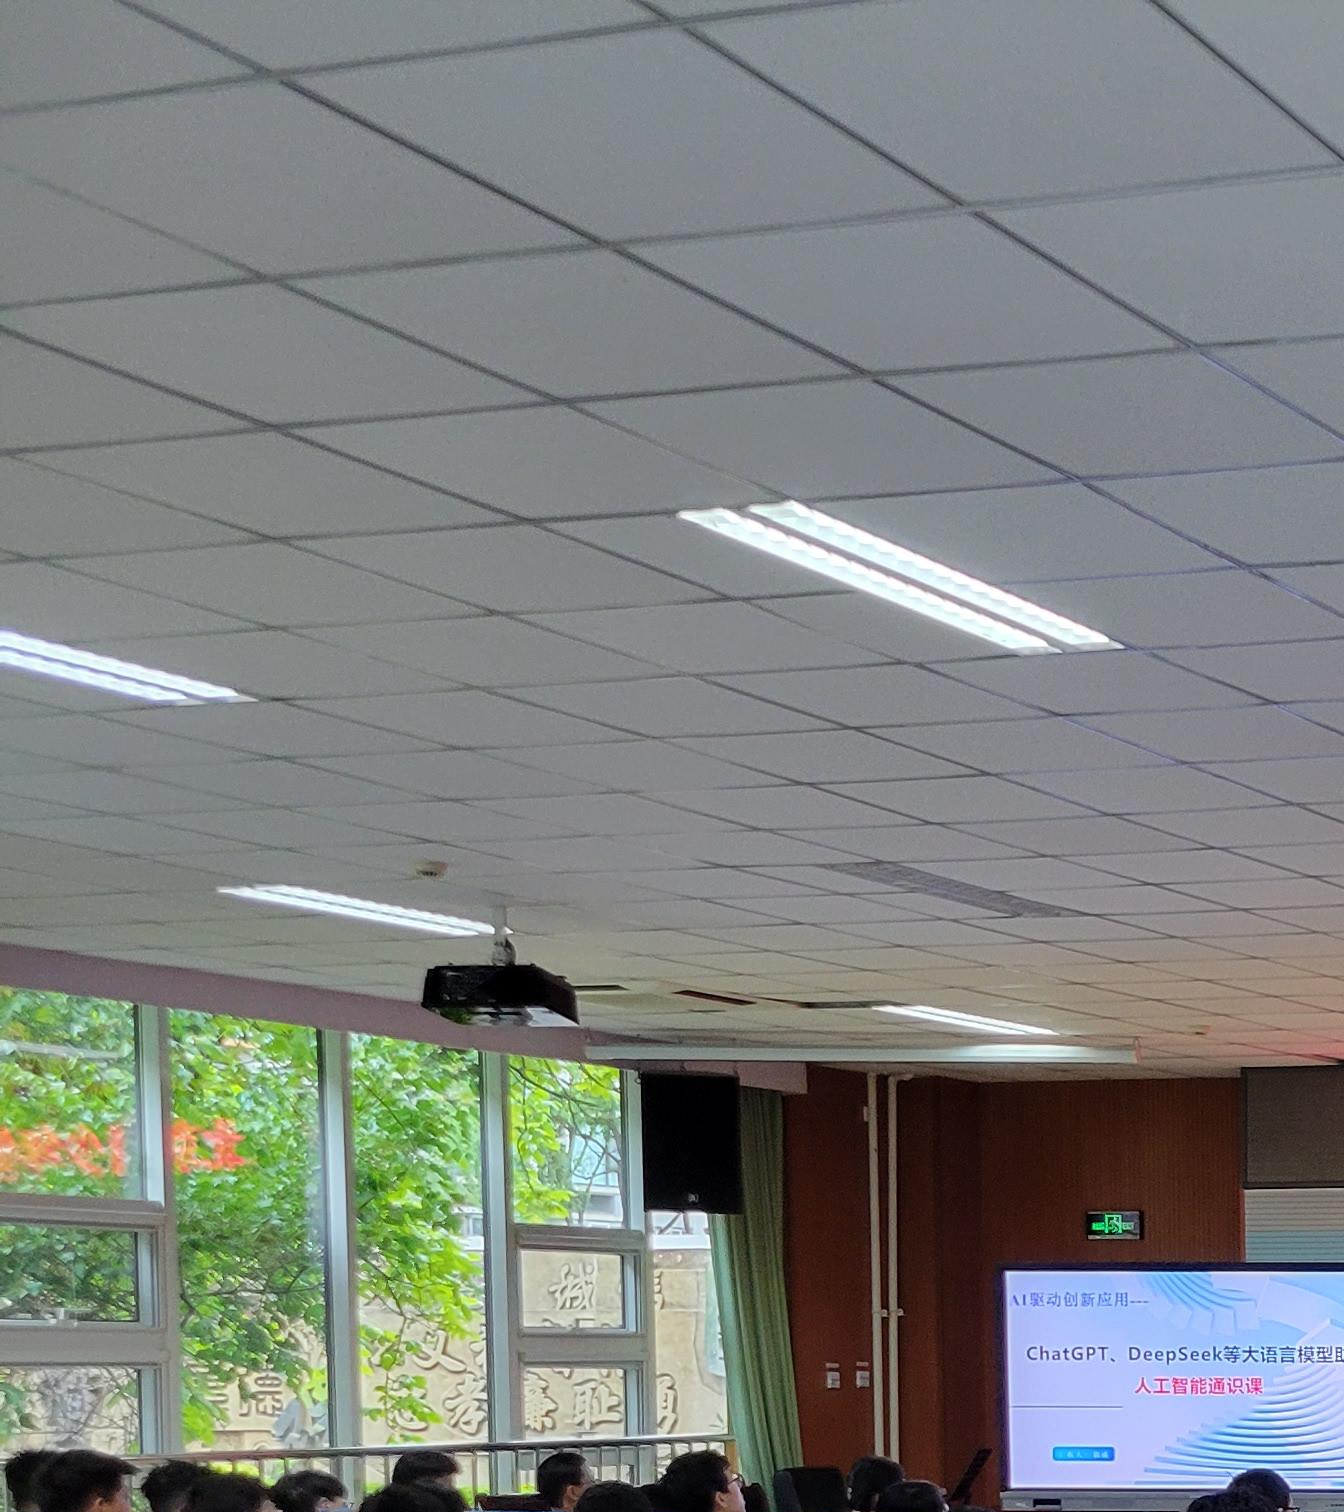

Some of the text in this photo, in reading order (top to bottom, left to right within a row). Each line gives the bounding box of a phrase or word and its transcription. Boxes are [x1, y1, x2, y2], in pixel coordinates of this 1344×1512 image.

[1134, 1377, 1264, 1396] 人工智能通识课
